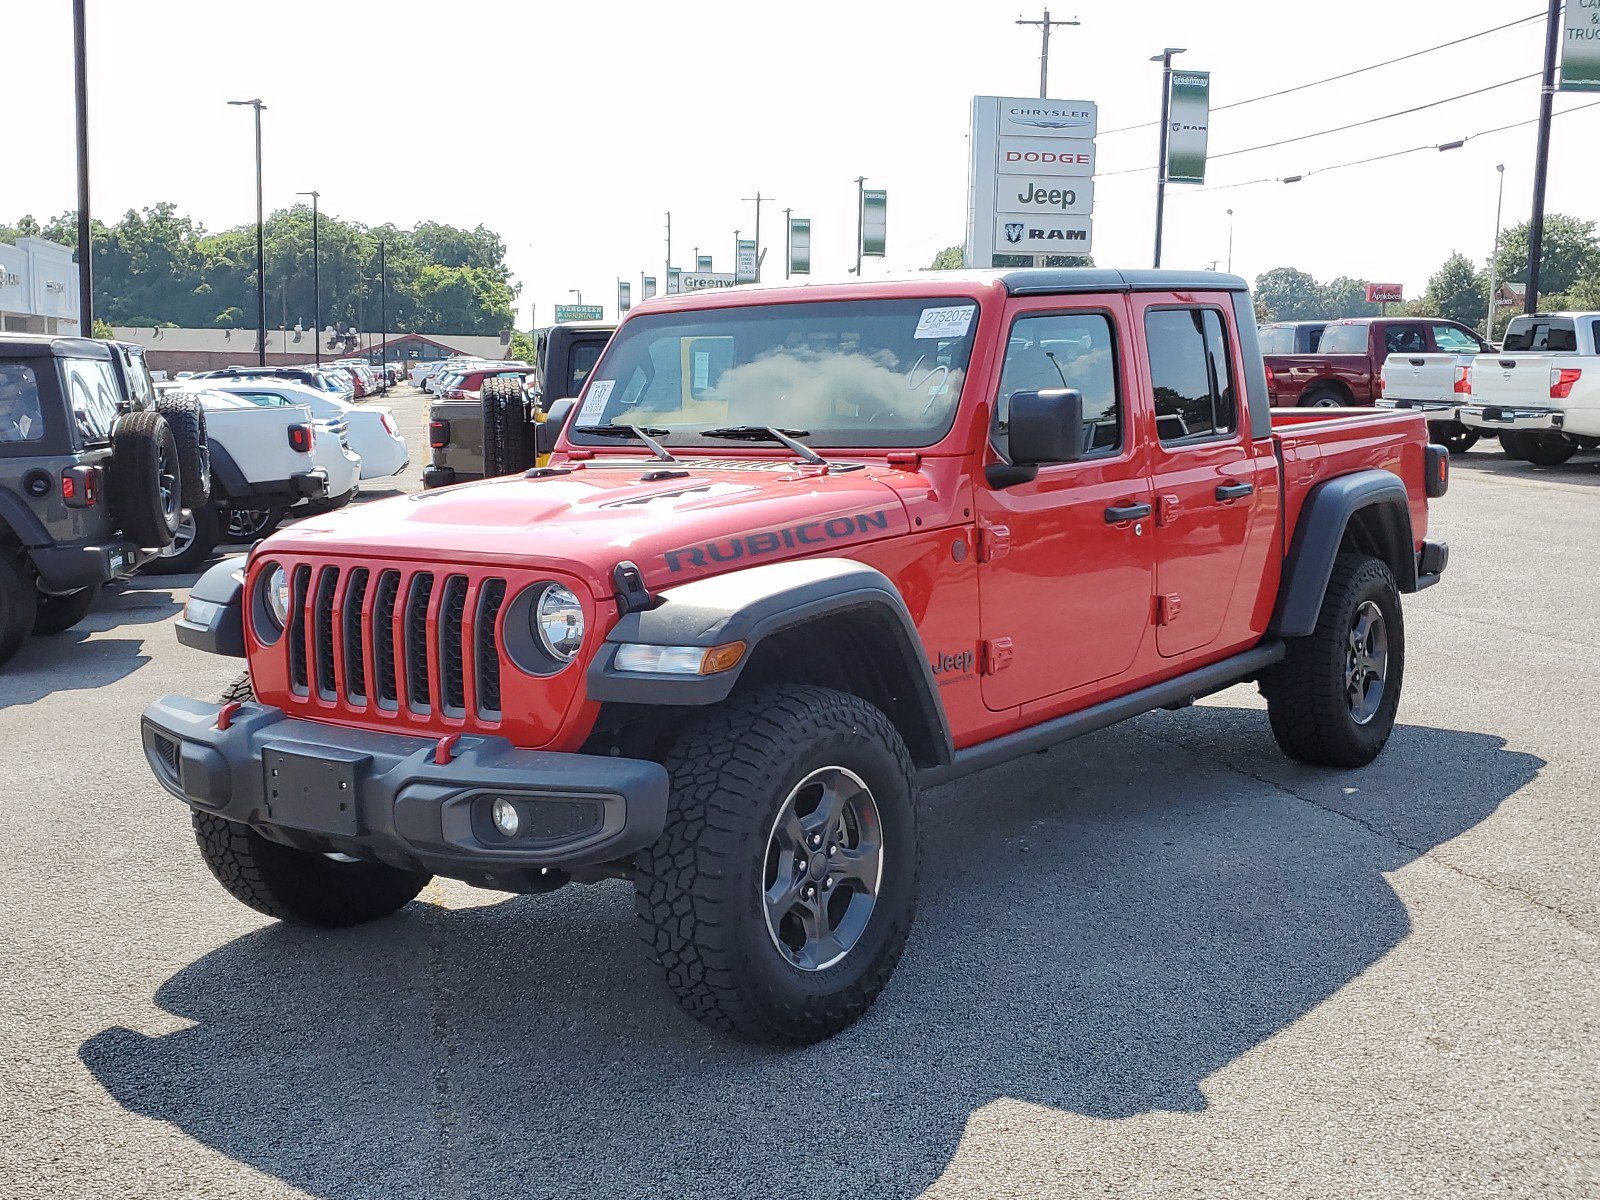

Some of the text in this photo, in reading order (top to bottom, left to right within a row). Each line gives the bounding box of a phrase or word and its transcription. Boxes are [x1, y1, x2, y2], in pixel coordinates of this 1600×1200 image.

[1591, 13, 1599, 24] &
[1010, 108, 1091, 118] CHRYSLER
[1006, 151, 1090, 164] DODGE
[1018, 183, 1076, 209] Jeep
[1028, 229, 1087, 241] RAM
[925, 310, 972, 323] 2752075
[663, 510, 888, 572] RUBICON
[932, 649, 975, 675] Jeep
